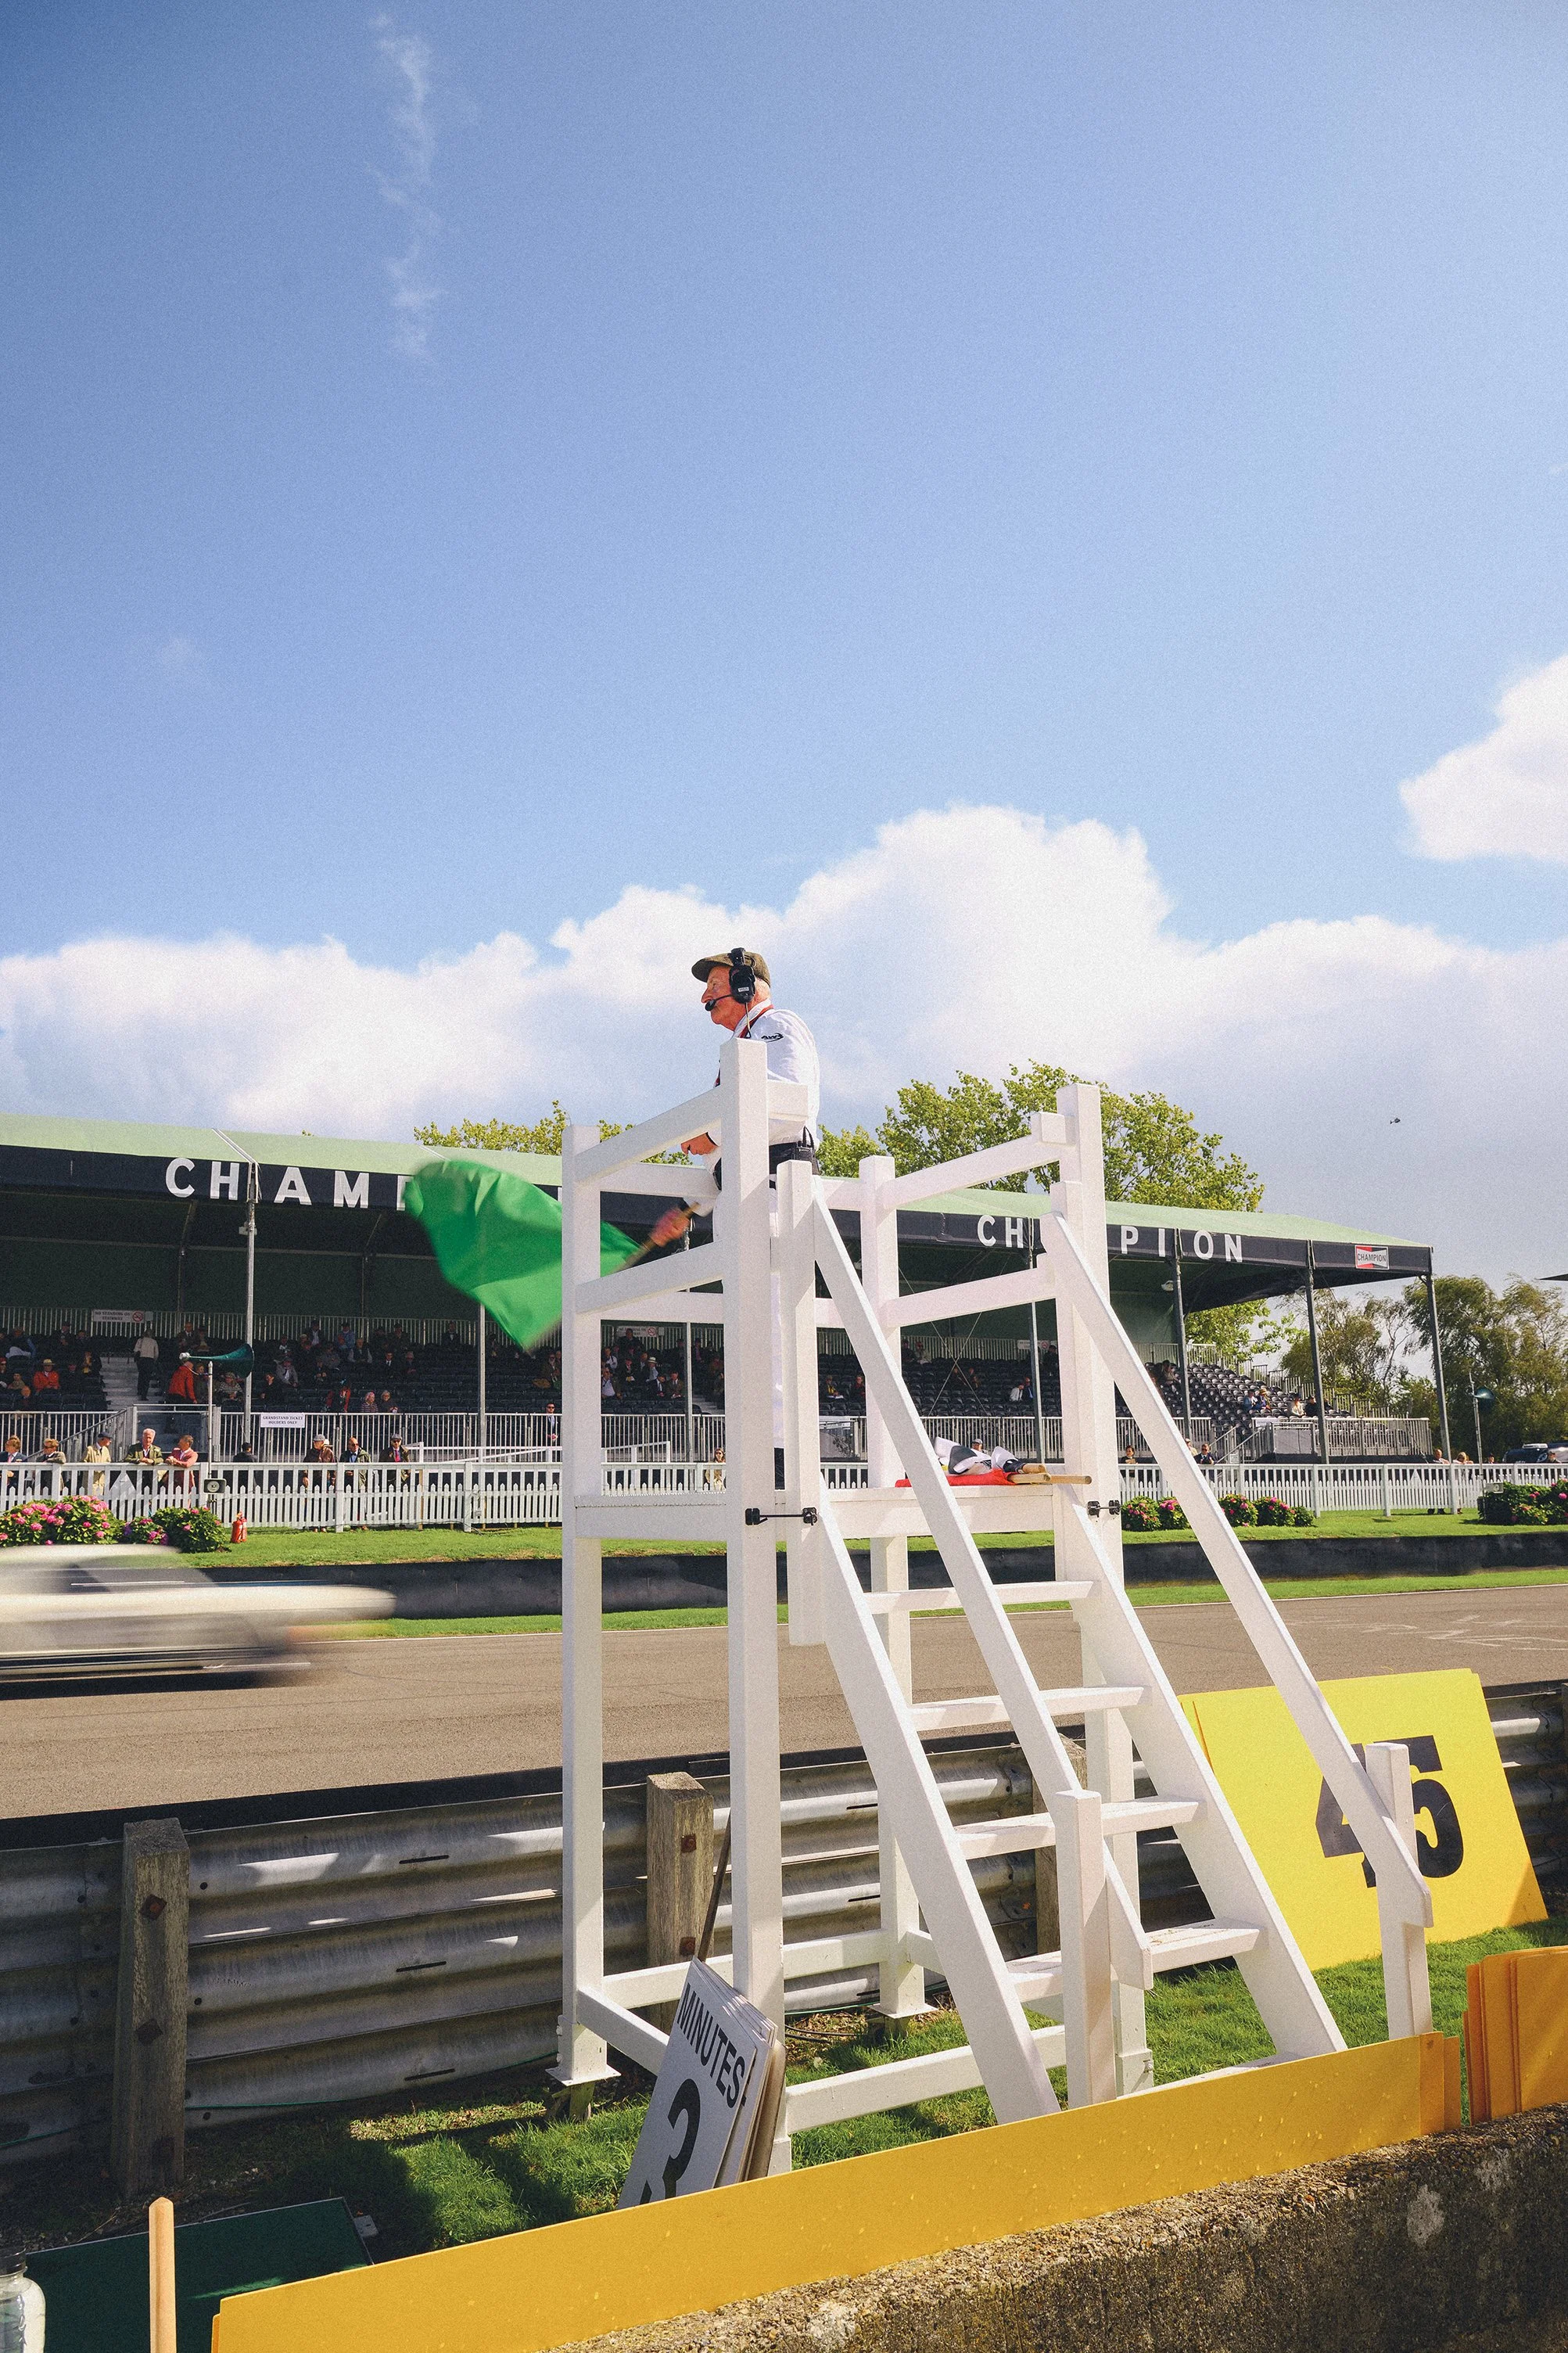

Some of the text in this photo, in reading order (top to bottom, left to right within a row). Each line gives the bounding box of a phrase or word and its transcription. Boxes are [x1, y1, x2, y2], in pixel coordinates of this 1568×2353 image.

[978, 1215, 1243, 1263] CHPION
[1357, 1253, 1387, 1262] CHAMPION
[676, 1982, 745, 2109] MINUTES
